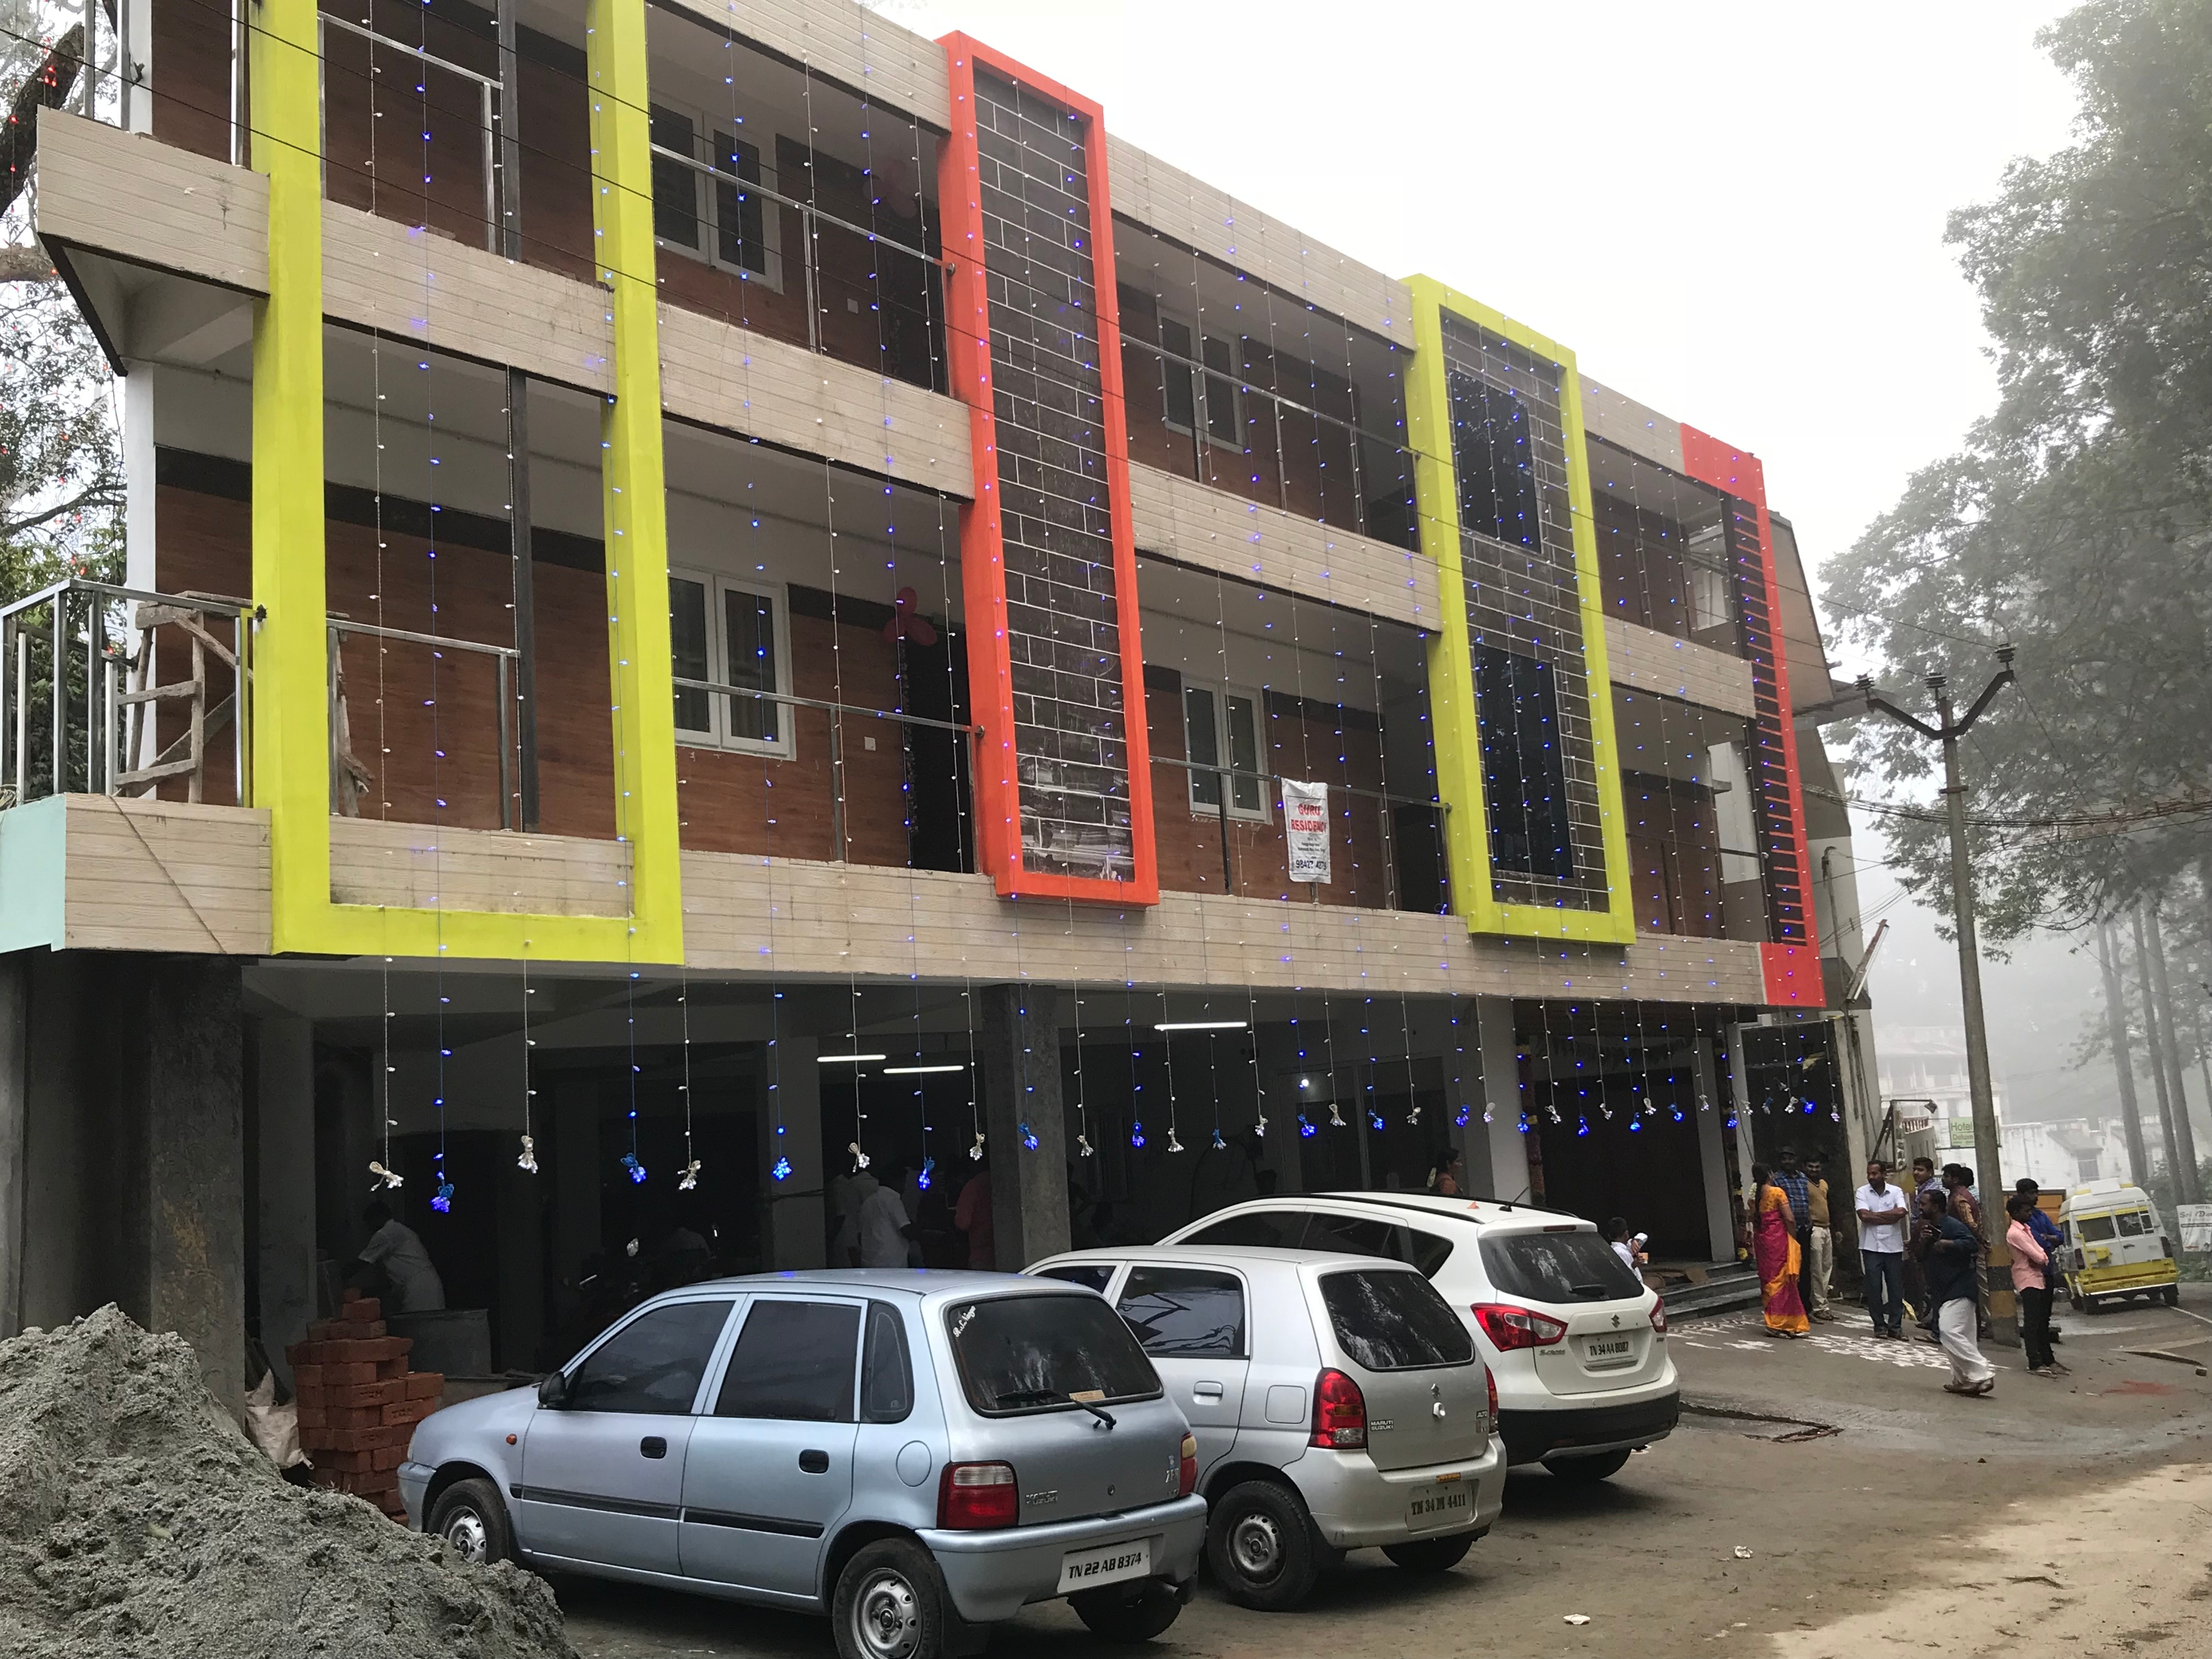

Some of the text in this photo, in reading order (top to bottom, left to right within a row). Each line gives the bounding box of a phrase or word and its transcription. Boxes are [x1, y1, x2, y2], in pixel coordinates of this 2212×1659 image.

[1298, 803, 1321, 816] GURU
[1291, 819, 1327, 833] RESIDENCY
[1950, 1121, 1973, 1131] Hotel
[1589, 1345, 1597, 1356] TN
[1598, 1344, 1605, 1355] 34
[1606, 1343, 1615, 1354] AA
[1411, 1500, 1423, 1515] TN
[1425, 1498, 1435, 1512] 34
[1447, 1493, 1466, 1508] 4411
[1069, 1552, 1142, 1579] TN 22 AB 8374
